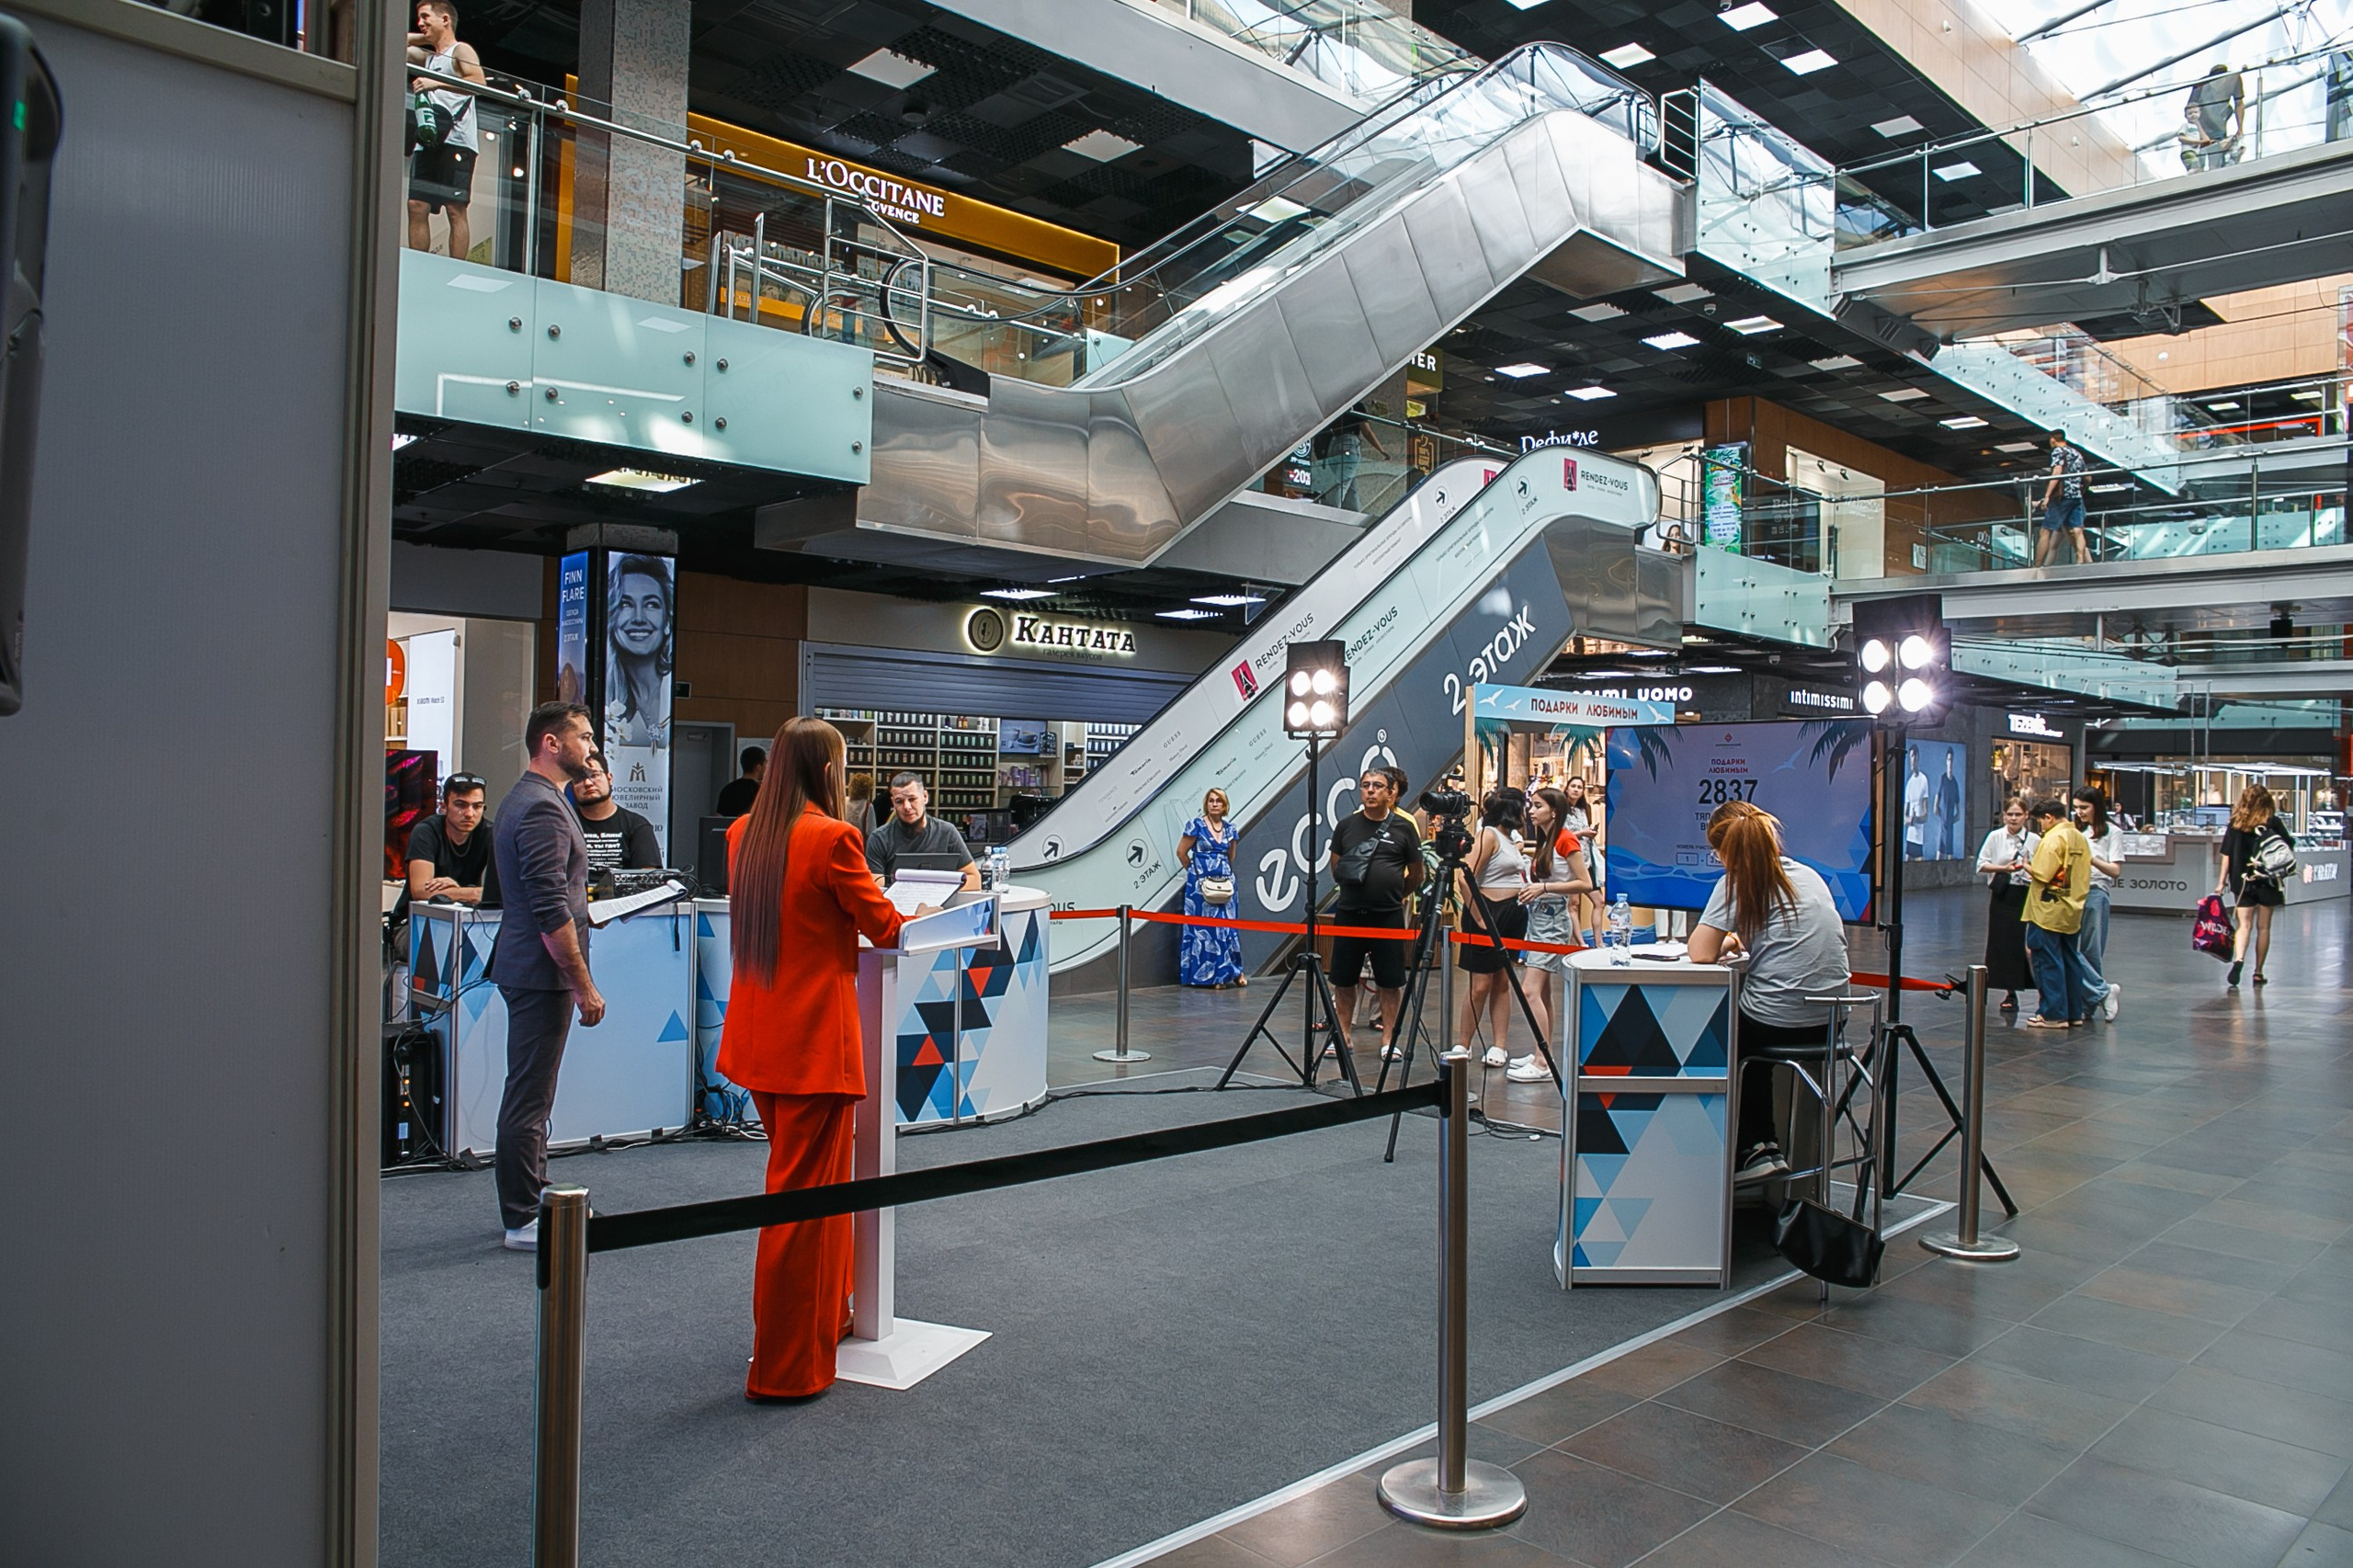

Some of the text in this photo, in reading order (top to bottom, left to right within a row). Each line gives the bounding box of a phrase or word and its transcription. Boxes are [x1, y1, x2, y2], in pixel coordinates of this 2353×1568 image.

[868, 199, 919, 224] OVENCE
[1581, 470, 1629, 491] RENDEZ-VOUS
[564, 569, 583, 585] FINN
[562, 586, 585, 603] FLARE
[1255, 612, 1315, 671] RENDEZ-VOUS
[1042, 647, 1103, 661] галерея вкусов
[1443, 672, 1467, 716] 2
[1790, 689, 1854, 710] intimissimi
[1530, 698, 1639, 721] ПОДАРКИ ЛЮБИМЫМ
[1698, 778, 1758, 804] 2837
[1695, 812, 1711, 821] ТЯП
[1133, 860, 1162, 889] 2 ЭТАЖ
[2130, 880, 2188, 891] ЗОЛОТО
